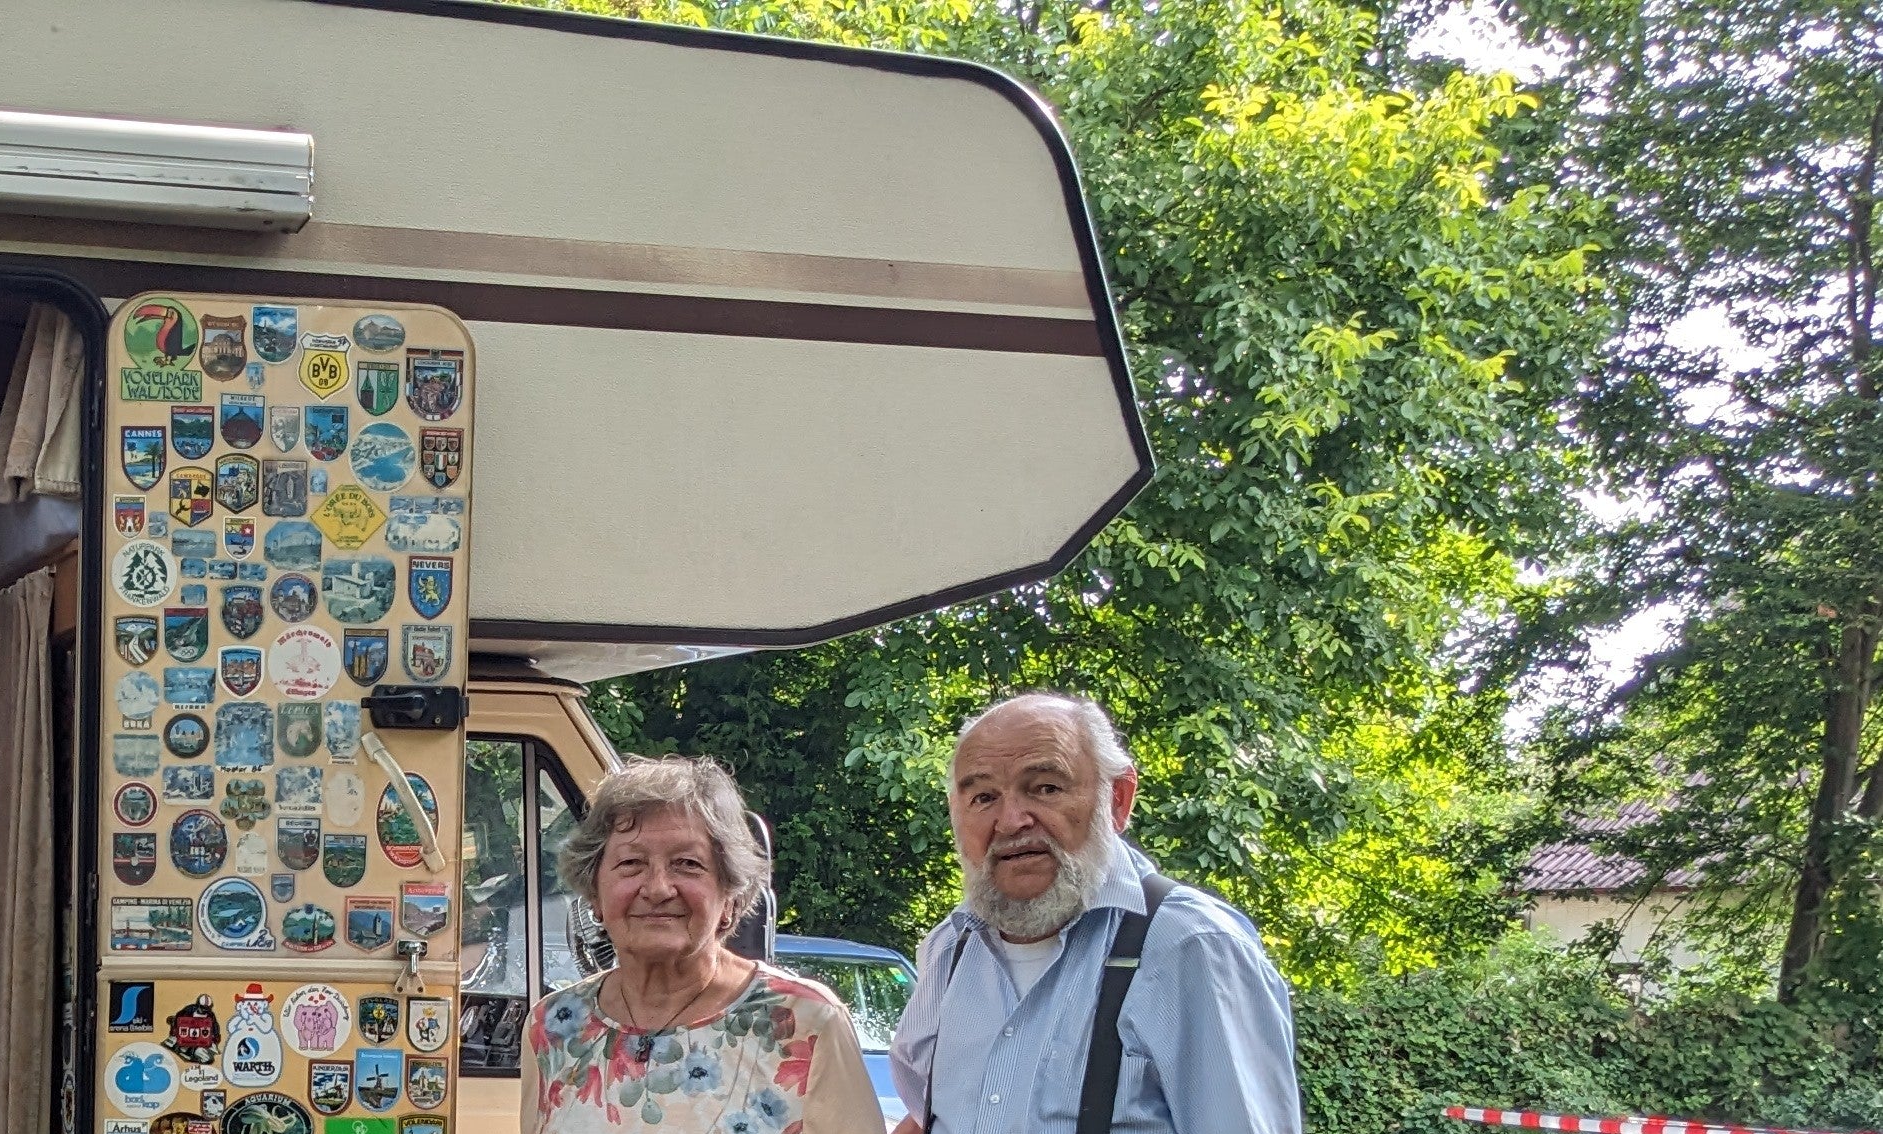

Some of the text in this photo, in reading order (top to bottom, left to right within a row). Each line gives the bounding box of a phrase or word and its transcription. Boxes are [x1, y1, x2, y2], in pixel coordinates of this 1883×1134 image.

[312, 357, 338, 379] BVB
[123, 370, 199, 387] VOGELPARK
[124, 429, 163, 438] CANNES
[122, 542, 166, 557] NATURPARK
[412, 561, 451, 570] NEVERS
[119, 586, 170, 606] FRANKENWALD
[233, 1061, 275, 1075] WARTH
[185, 1070, 218, 1083] Legoland
[244, 1093, 292, 1105] AQUARIUM
